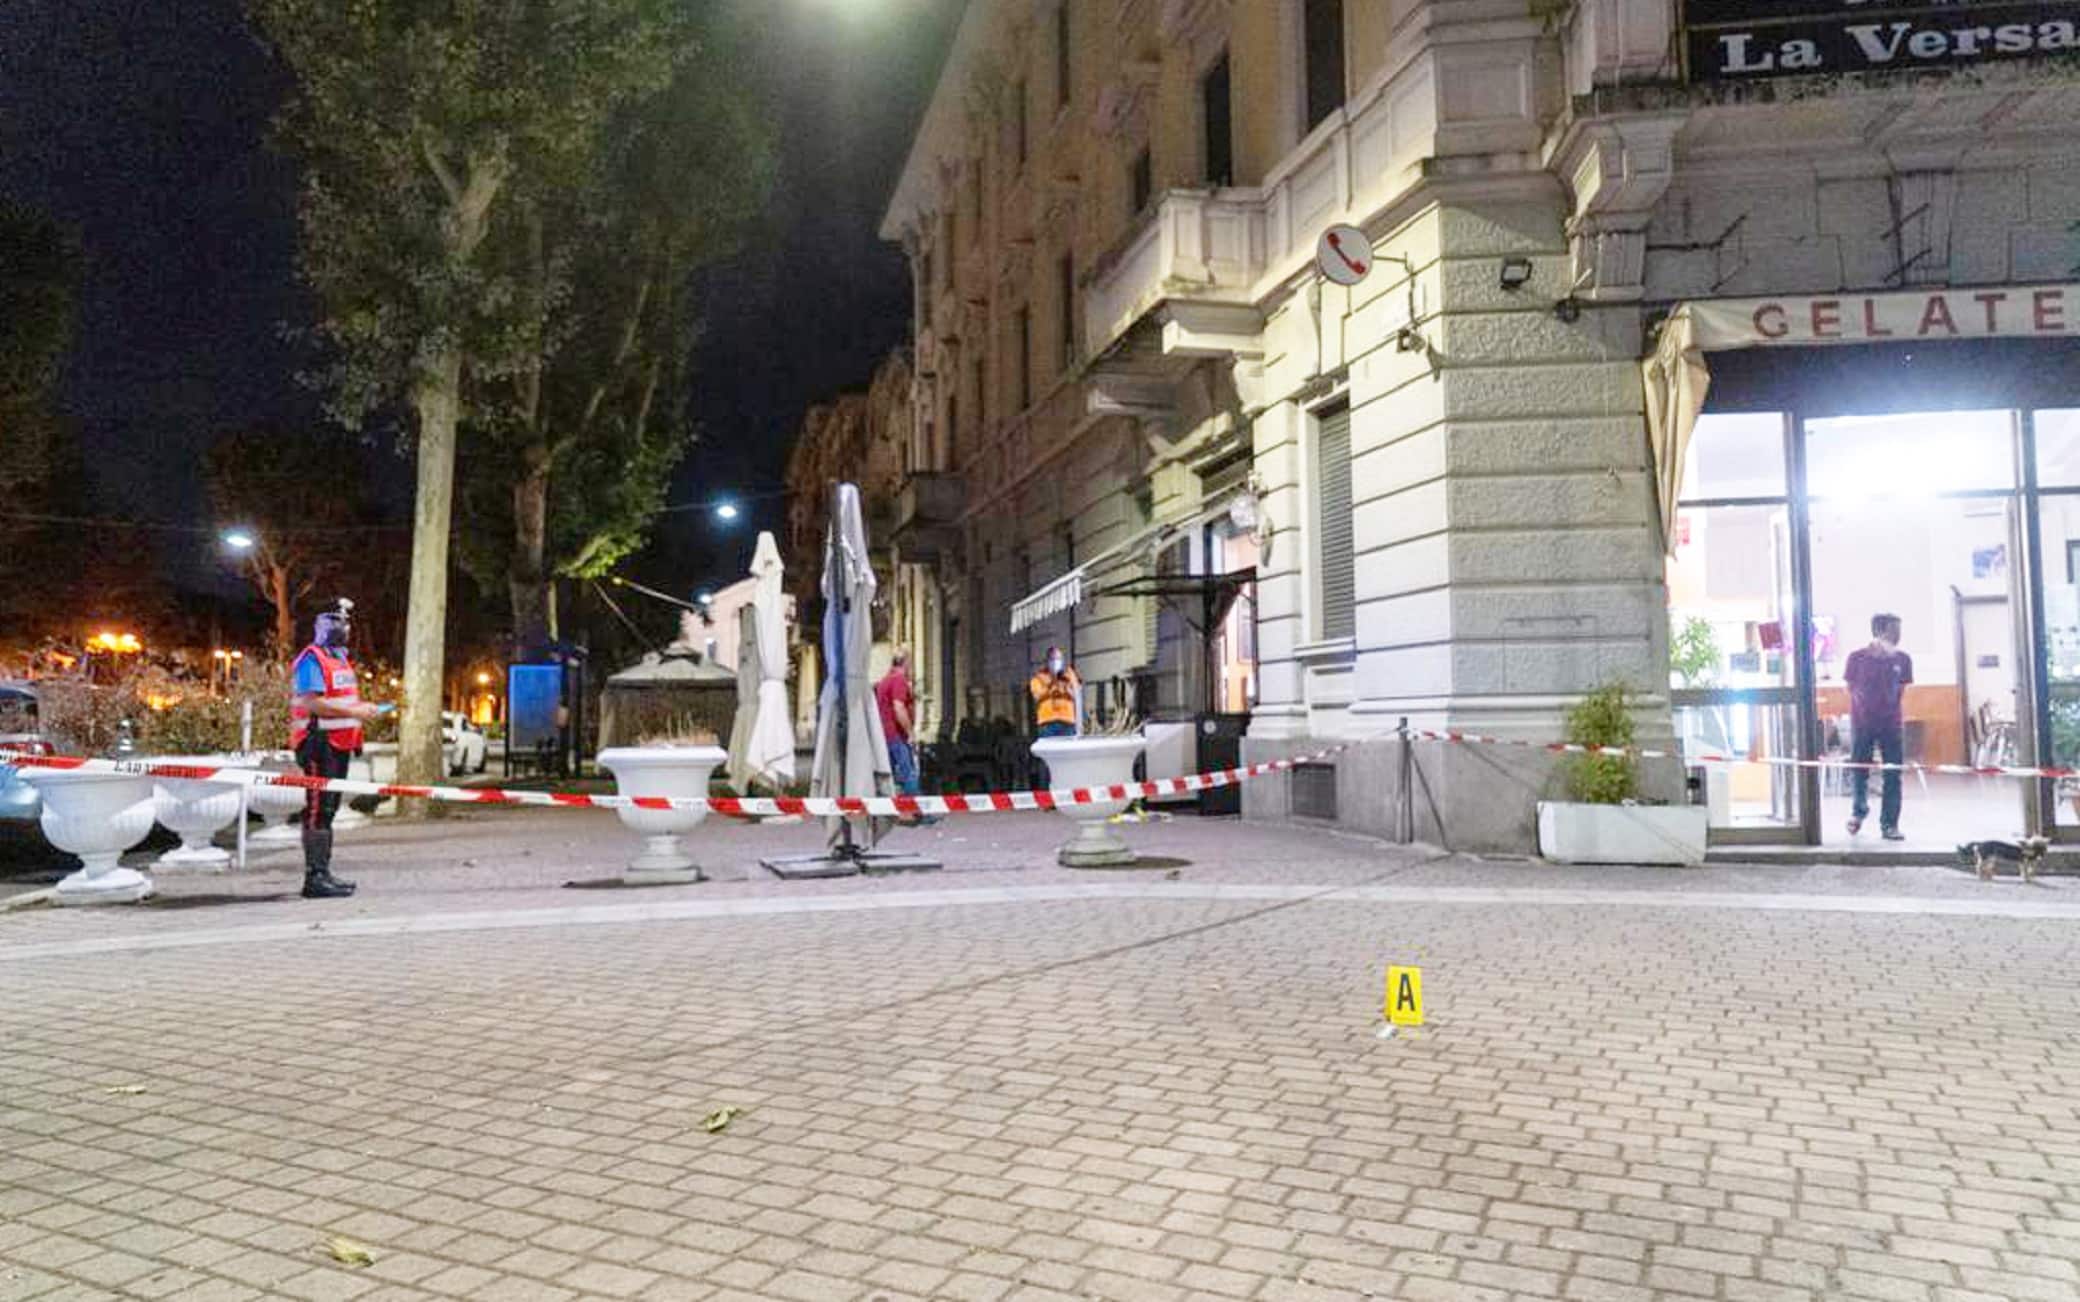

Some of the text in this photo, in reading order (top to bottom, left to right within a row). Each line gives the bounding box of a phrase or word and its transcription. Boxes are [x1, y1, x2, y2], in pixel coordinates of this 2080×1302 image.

[1719, 19, 2080, 73] La Versa
[1752, 290, 2066, 337] GELATE
[1397, 973, 1416, 1011] A
